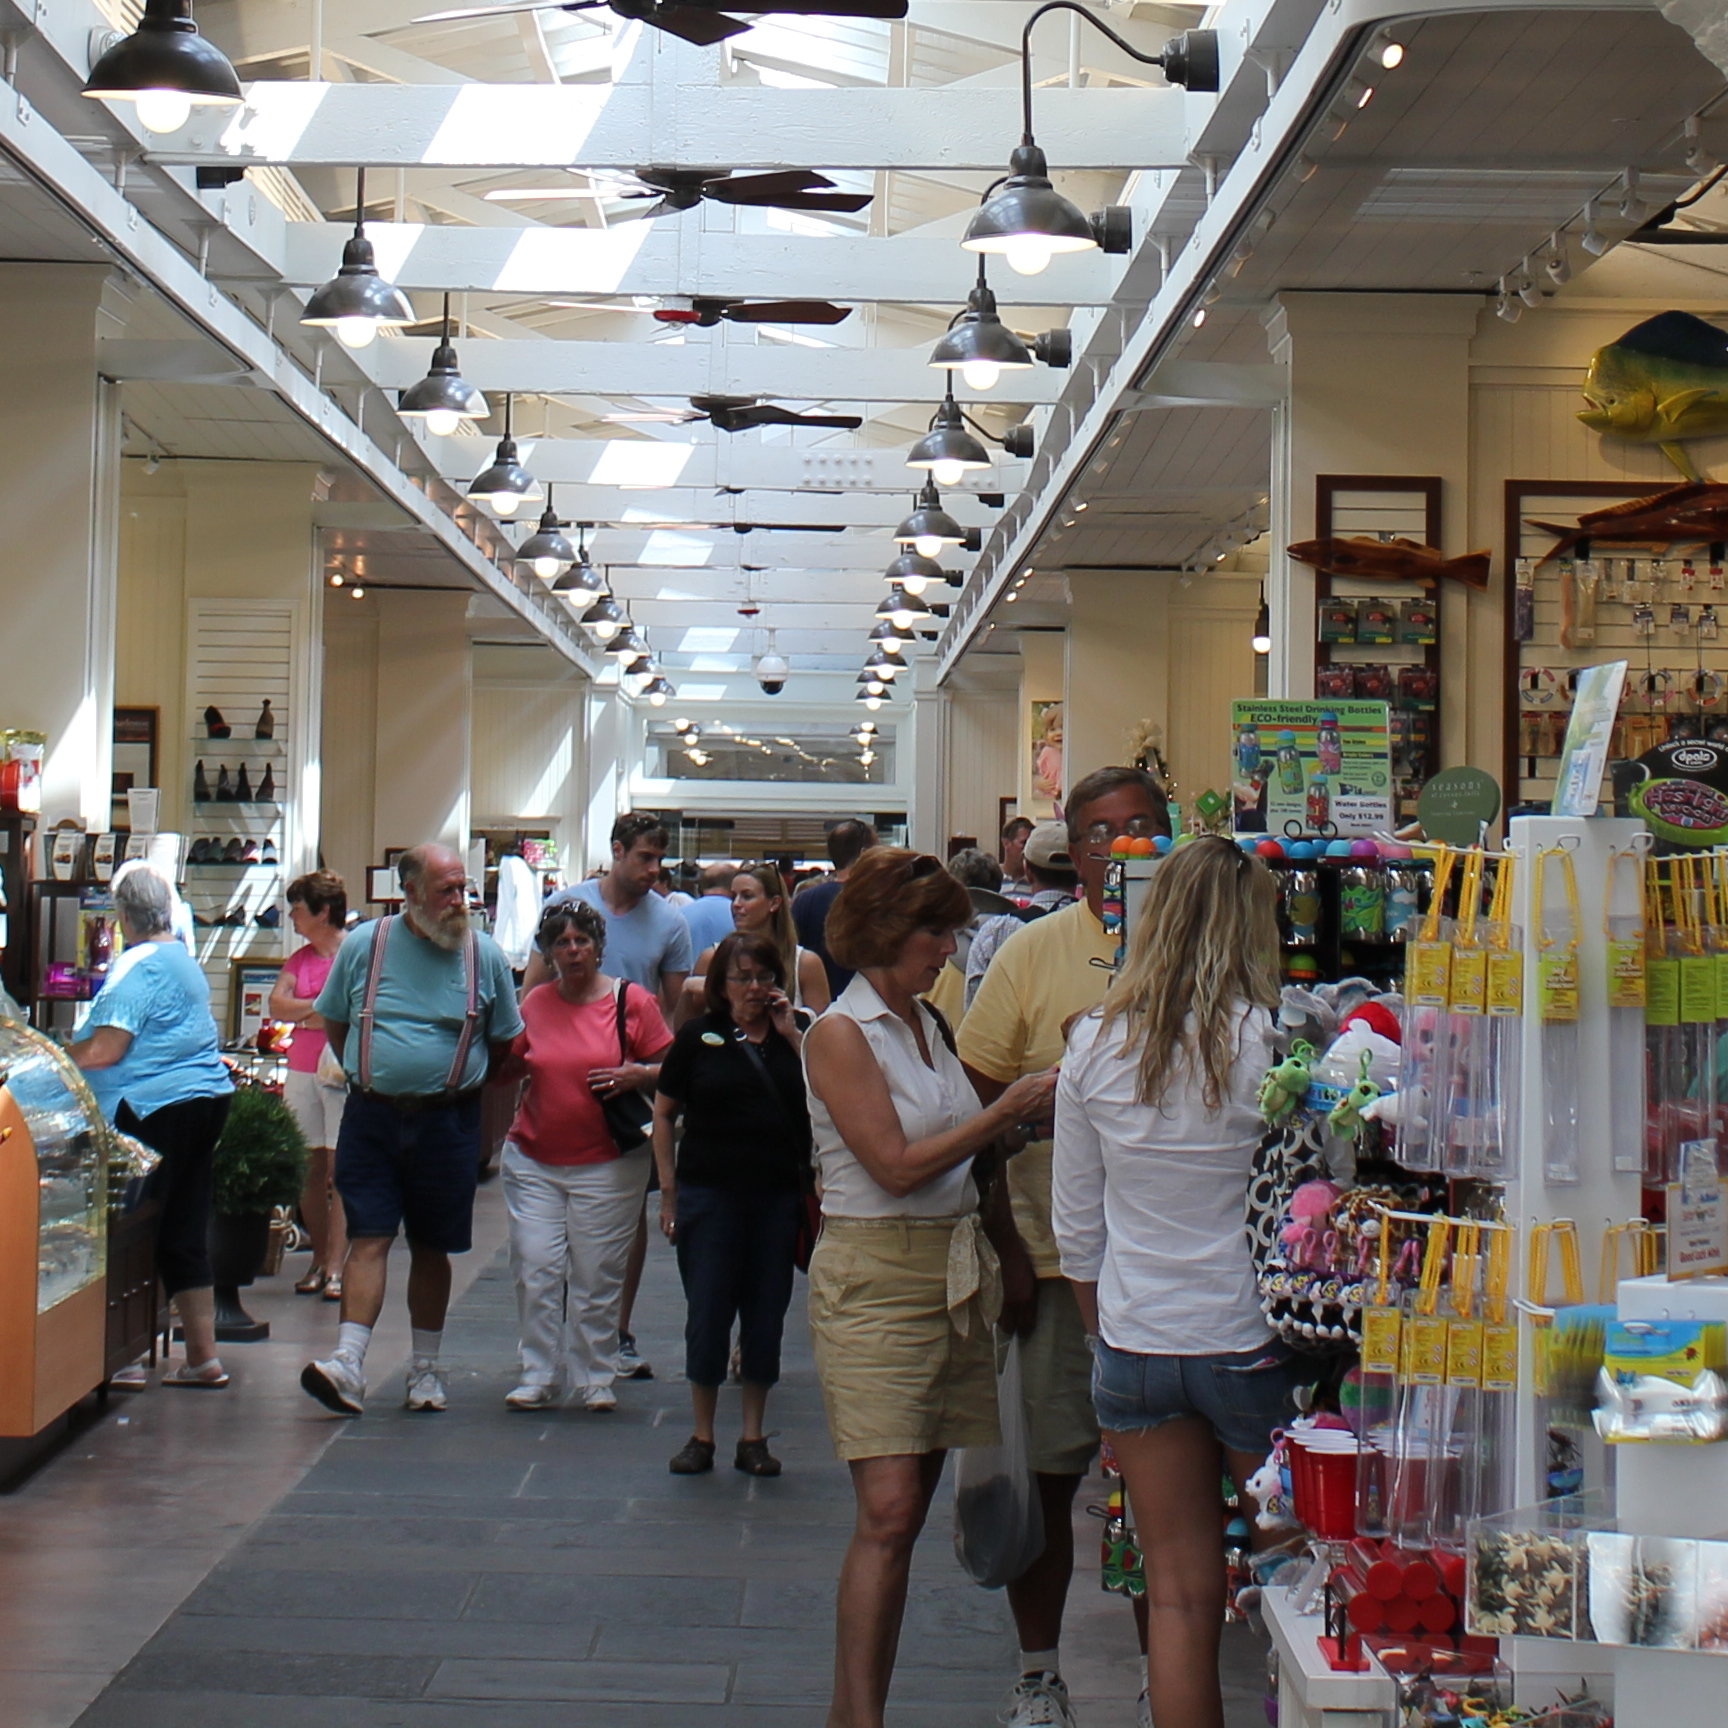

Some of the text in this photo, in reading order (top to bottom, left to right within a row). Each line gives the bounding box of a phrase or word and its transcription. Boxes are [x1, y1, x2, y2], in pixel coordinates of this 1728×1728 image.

[1236, 704, 1277, 713] Stainless
[1279, 704, 1303, 713] Steel
[1348, 705, 1382, 714] Bottles
